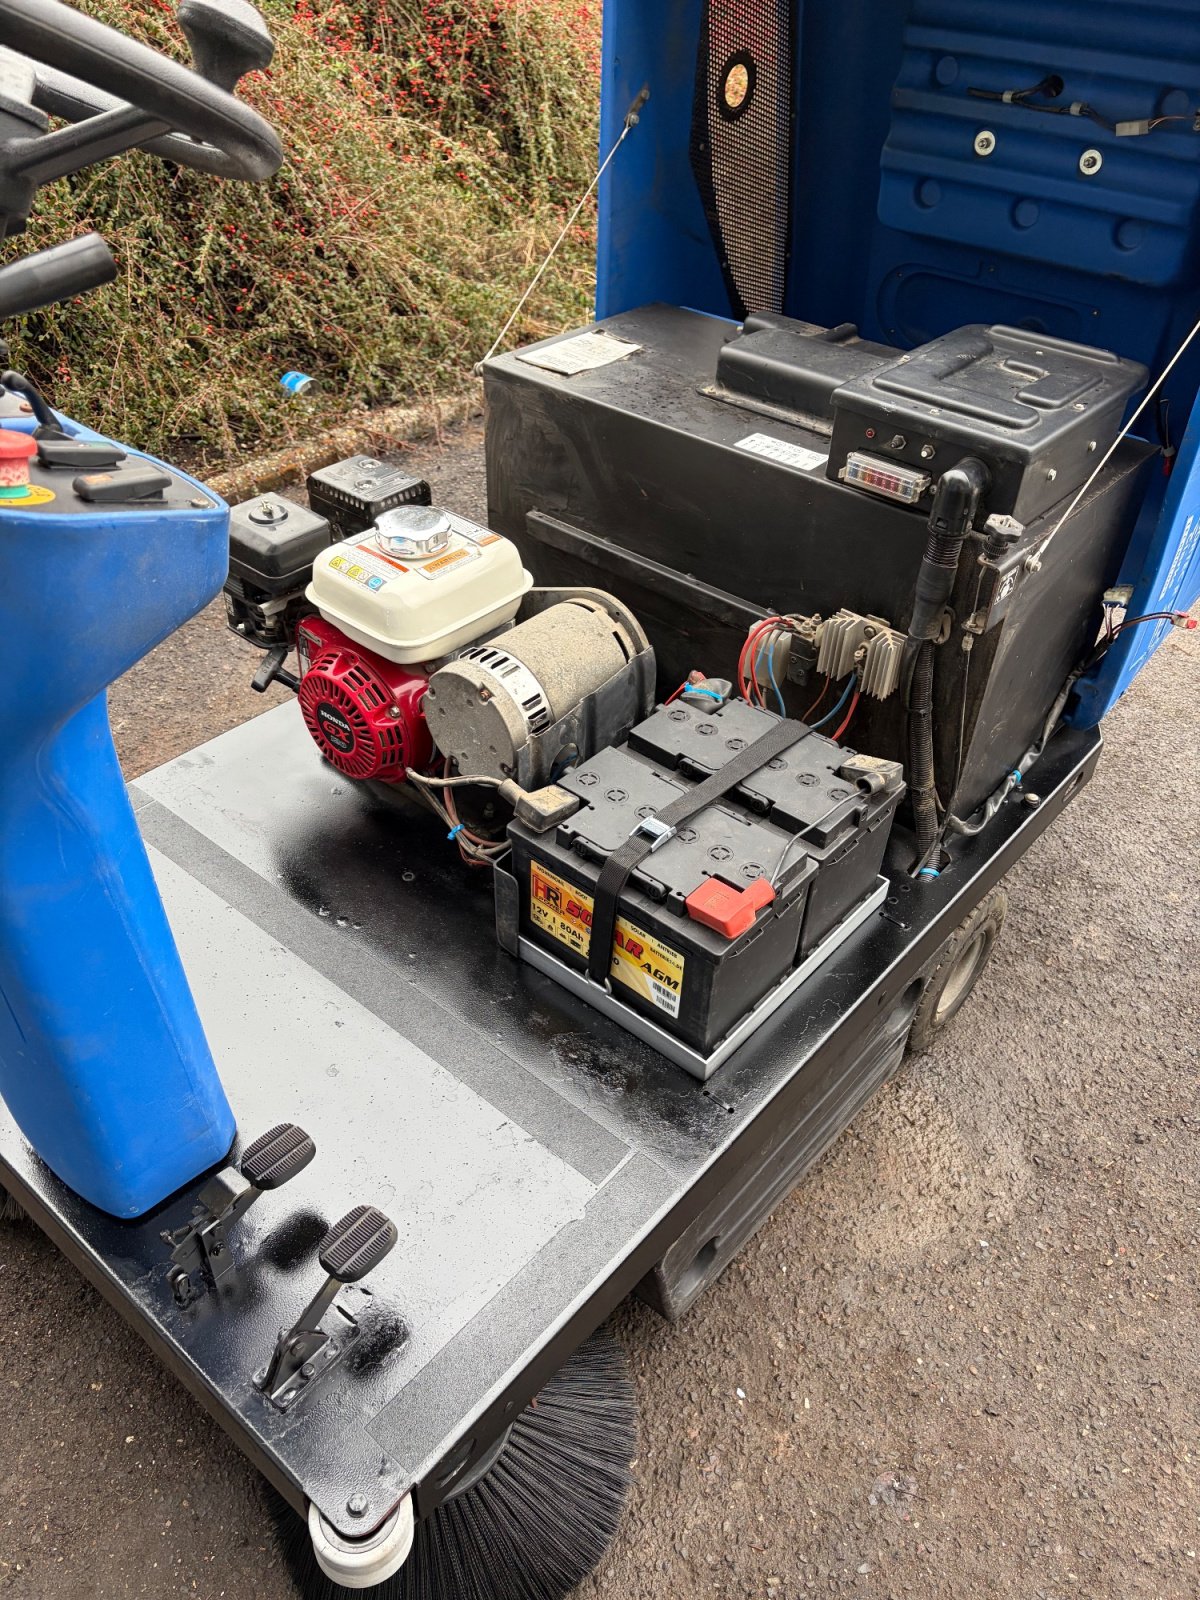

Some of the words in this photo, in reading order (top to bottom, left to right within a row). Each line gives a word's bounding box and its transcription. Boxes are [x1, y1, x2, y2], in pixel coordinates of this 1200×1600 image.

[320, 709, 351, 732] HONDA
[323, 720, 350, 744] GX
[533, 876, 560, 907] HR
[538, 895, 566, 916] POWER
[532, 902, 549, 918] 12V
[560, 922, 584, 943] 80Ah
[630, 925, 646, 938] SOLAR
[656, 943, 678, 959] ANTRIEB
[640, 962, 680, 991] AGM
